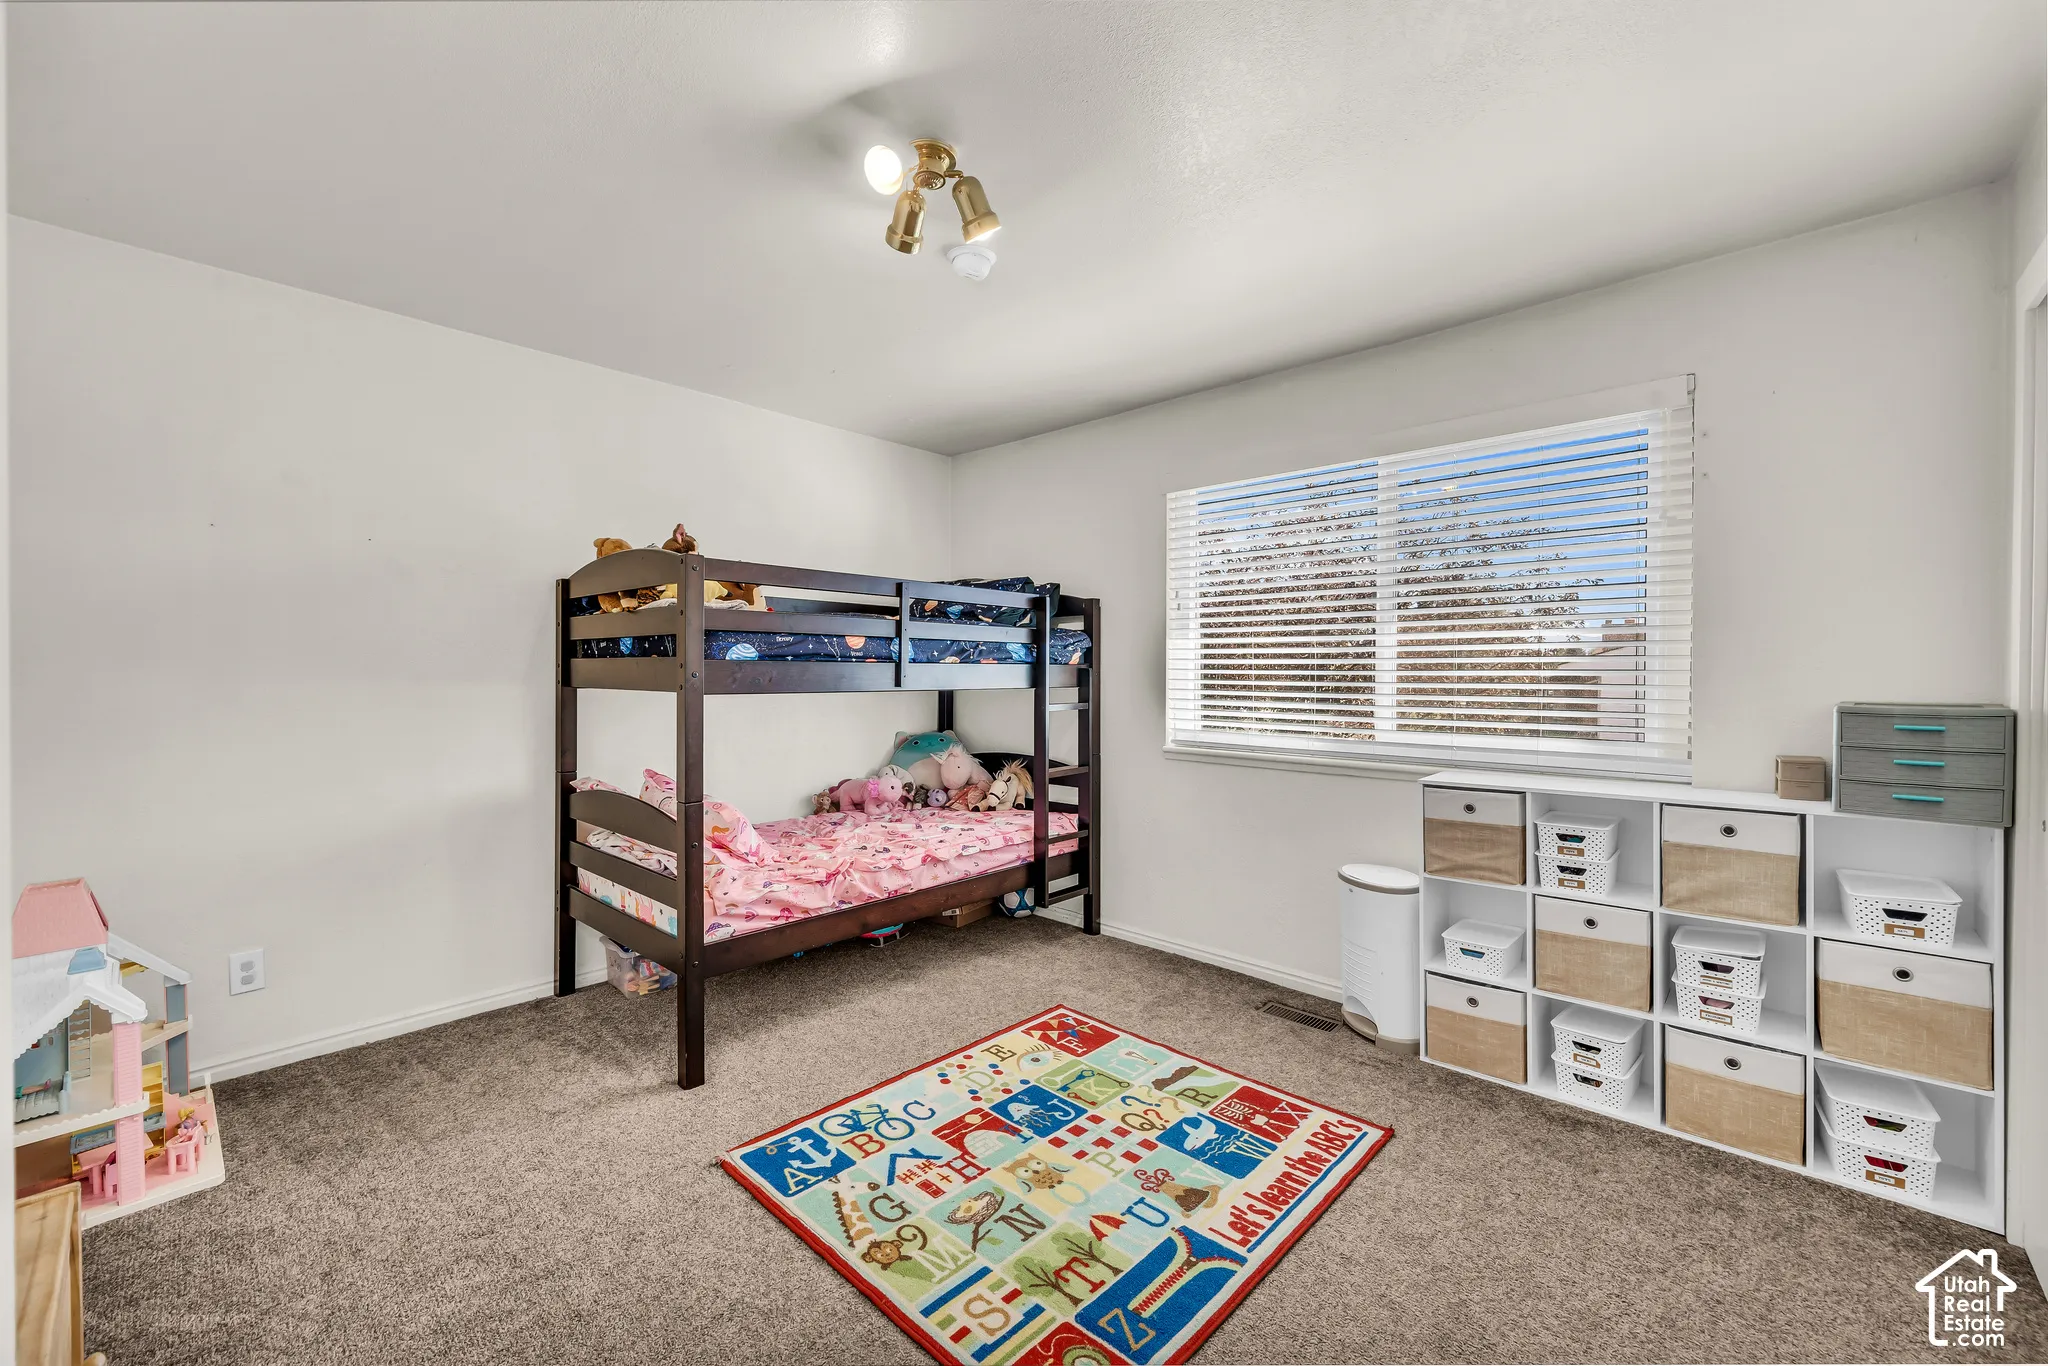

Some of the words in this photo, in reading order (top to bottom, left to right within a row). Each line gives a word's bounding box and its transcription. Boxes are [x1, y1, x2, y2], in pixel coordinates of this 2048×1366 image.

[980, 1044, 1018, 1063] E
[1056, 1036, 1087, 1054] F
[958, 1070, 996, 1091] D
[1108, 1059, 1147, 1077] L
[1074, 1080, 1119, 1101] K
[1175, 1087, 1219, 1108] R
[902, 1099, 936, 1121] C
[1047, 1098, 1076, 1120] J
[1120, 1112, 1168, 1131] Q
[1271, 1101, 1313, 1122] X
[842, 1133, 887, 1160] B
[1226, 1133, 1273, 1161] W
[1304, 1119, 1363, 1158] ABC's
[937, 1150, 991, 1185] H
[1085, 1151, 1125, 1178] P
[1180, 1163, 1225, 1185] V
[1283, 1150, 1332, 1177] the
[783, 1167, 823, 1195] A
[1051, 1181, 1091, 1207] O
[1242, 1171, 1312, 1212] learn
[868, 1193, 912, 1223] G
[1120, 1196, 1170, 1228] U
[996, 1203, 1047, 1242] N
[1208, 1203, 1276, 1248] Let's
[912, 1236, 977, 1284] M
[1052, 1256, 1107, 1294] T
[963, 1293, 1011, 1336] S
[1097, 1307, 1156, 1351] Z
